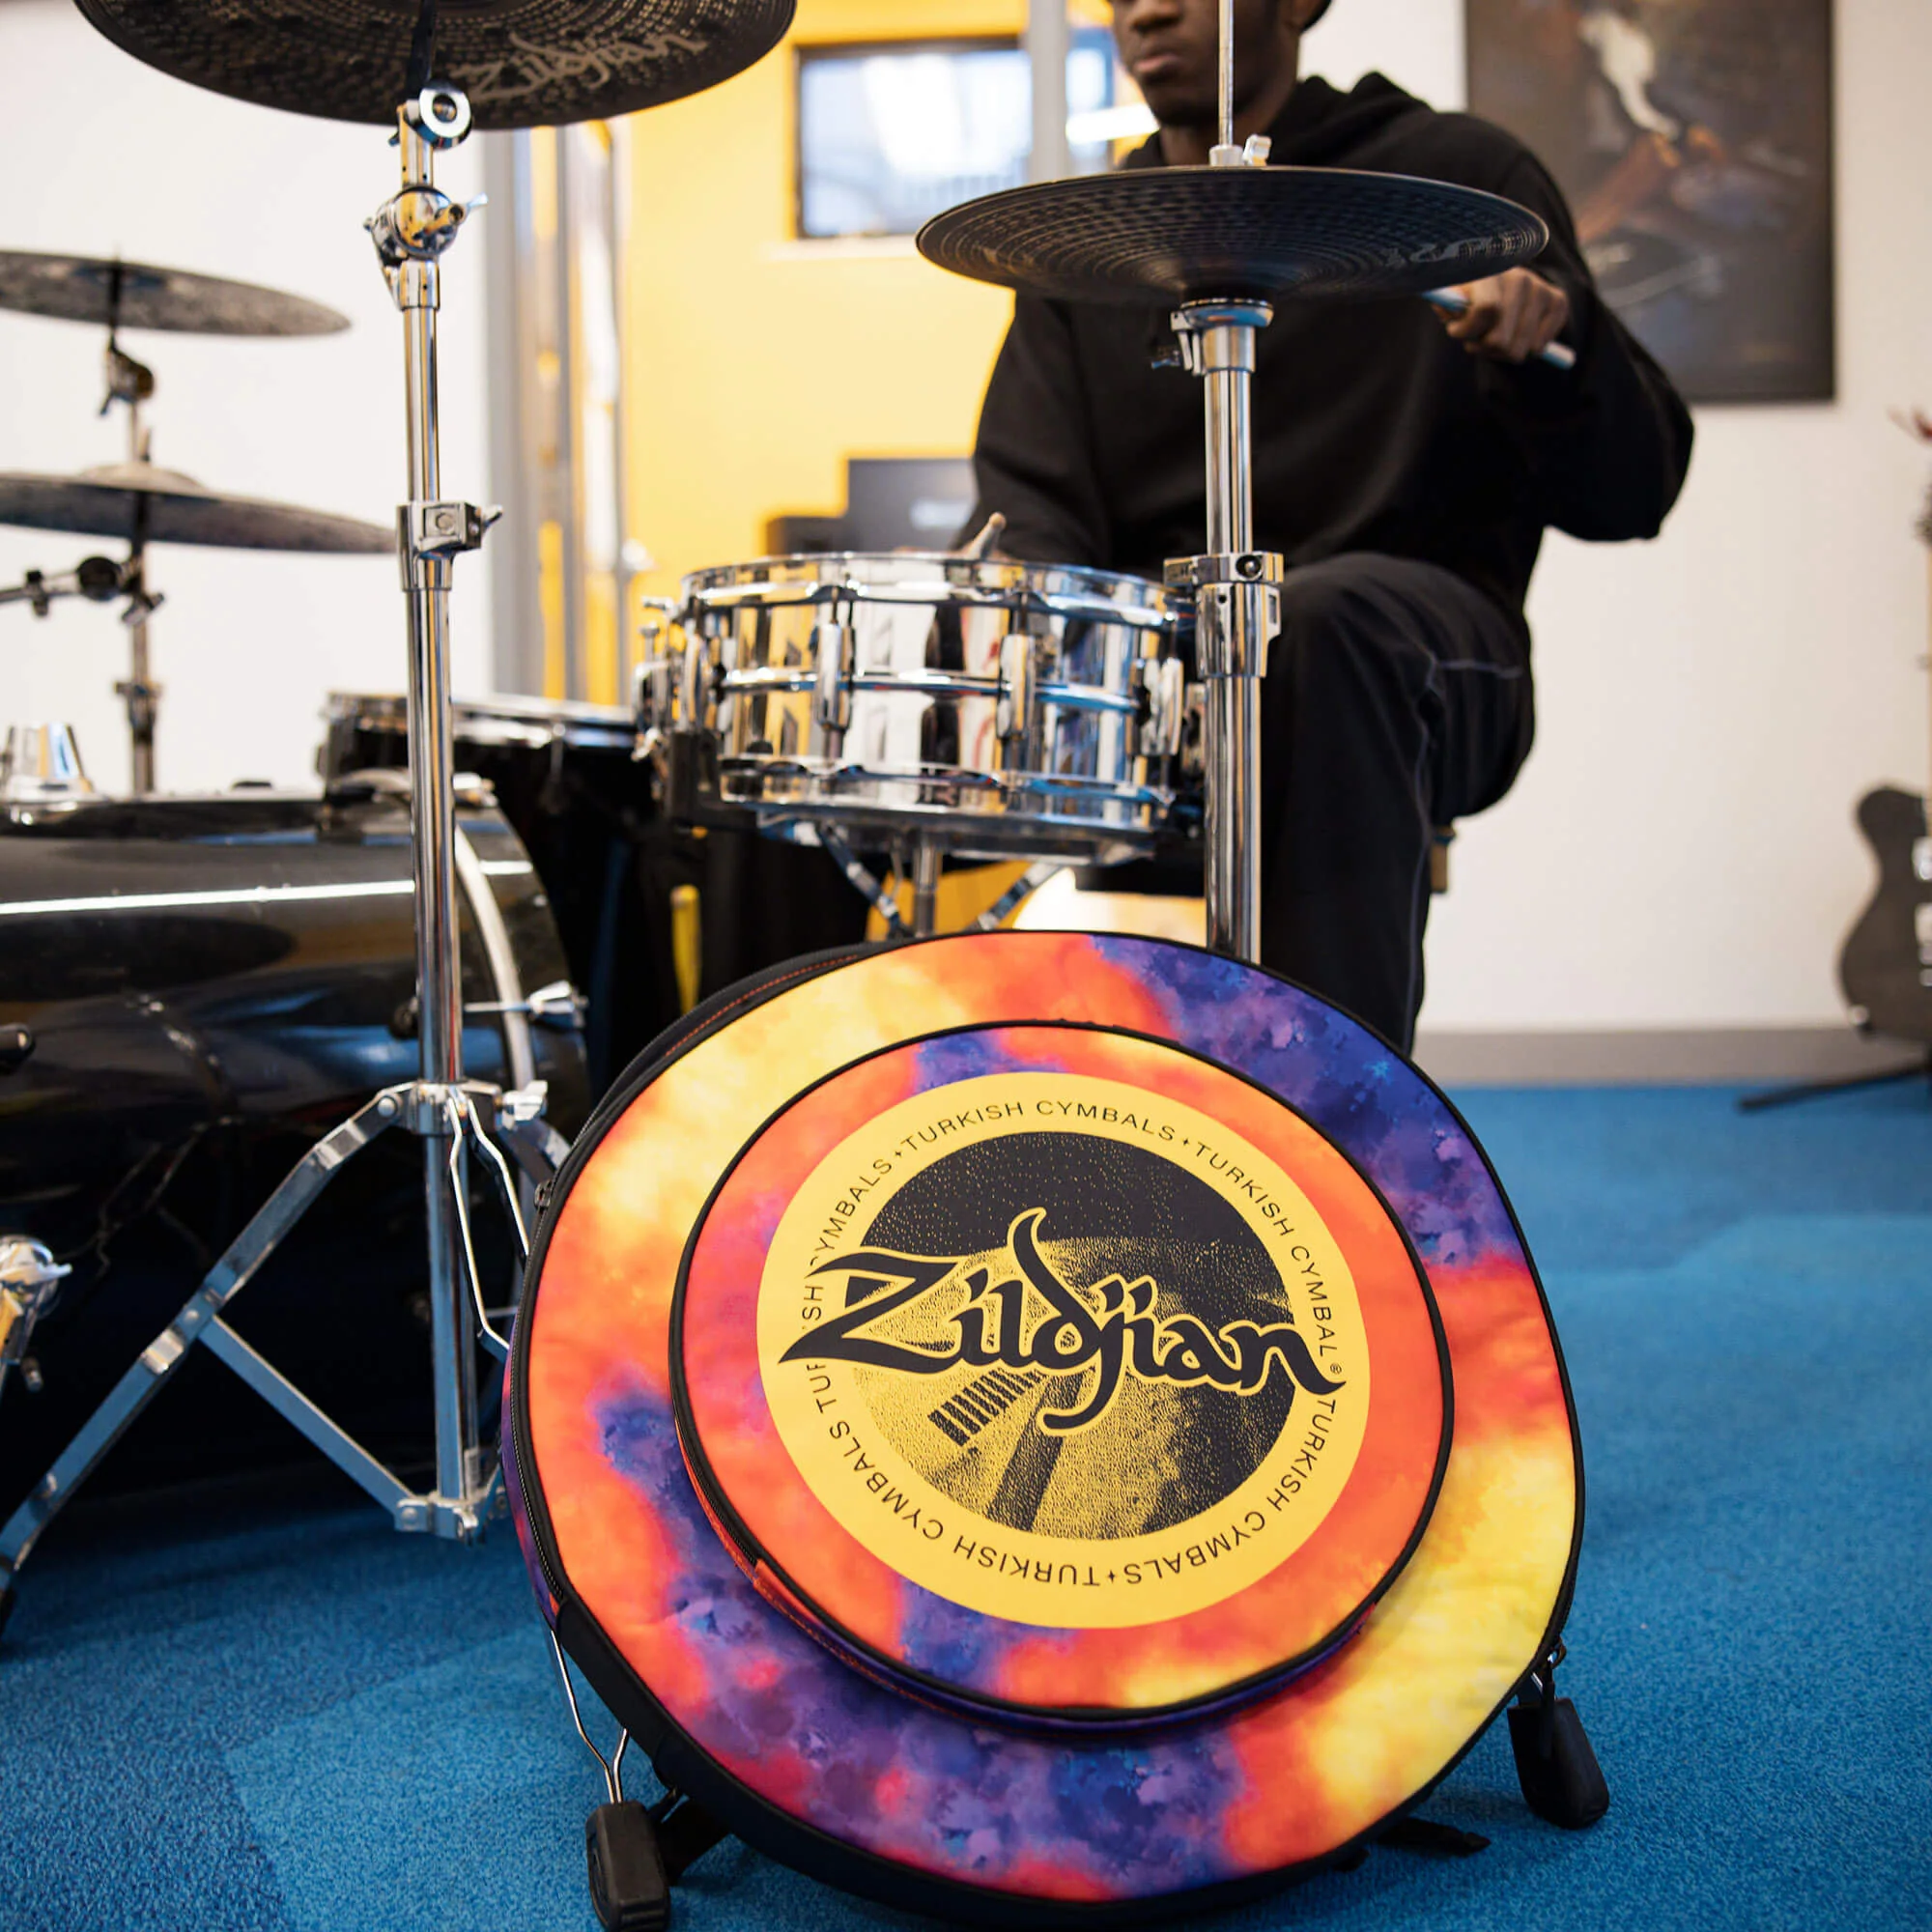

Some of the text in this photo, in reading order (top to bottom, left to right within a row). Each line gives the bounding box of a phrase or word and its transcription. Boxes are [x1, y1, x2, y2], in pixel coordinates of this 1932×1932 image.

[899, 1101, 1024, 1151] TURKISH
[1036, 1100, 1176, 1143] CYMBALS
[1195, 1141, 1294, 1237] TURKISH
[779, 1209, 1347, 1432] Zildjian
[801, 1286, 837, 1414] TUSH
[829, 1421, 944, 1540] CYMBALS
[1265, 1398, 1337, 1512] TURKISH
[952, 1535, 1100, 1587] TURKISH
[1123, 1511, 1265, 1584] CYMBALS
